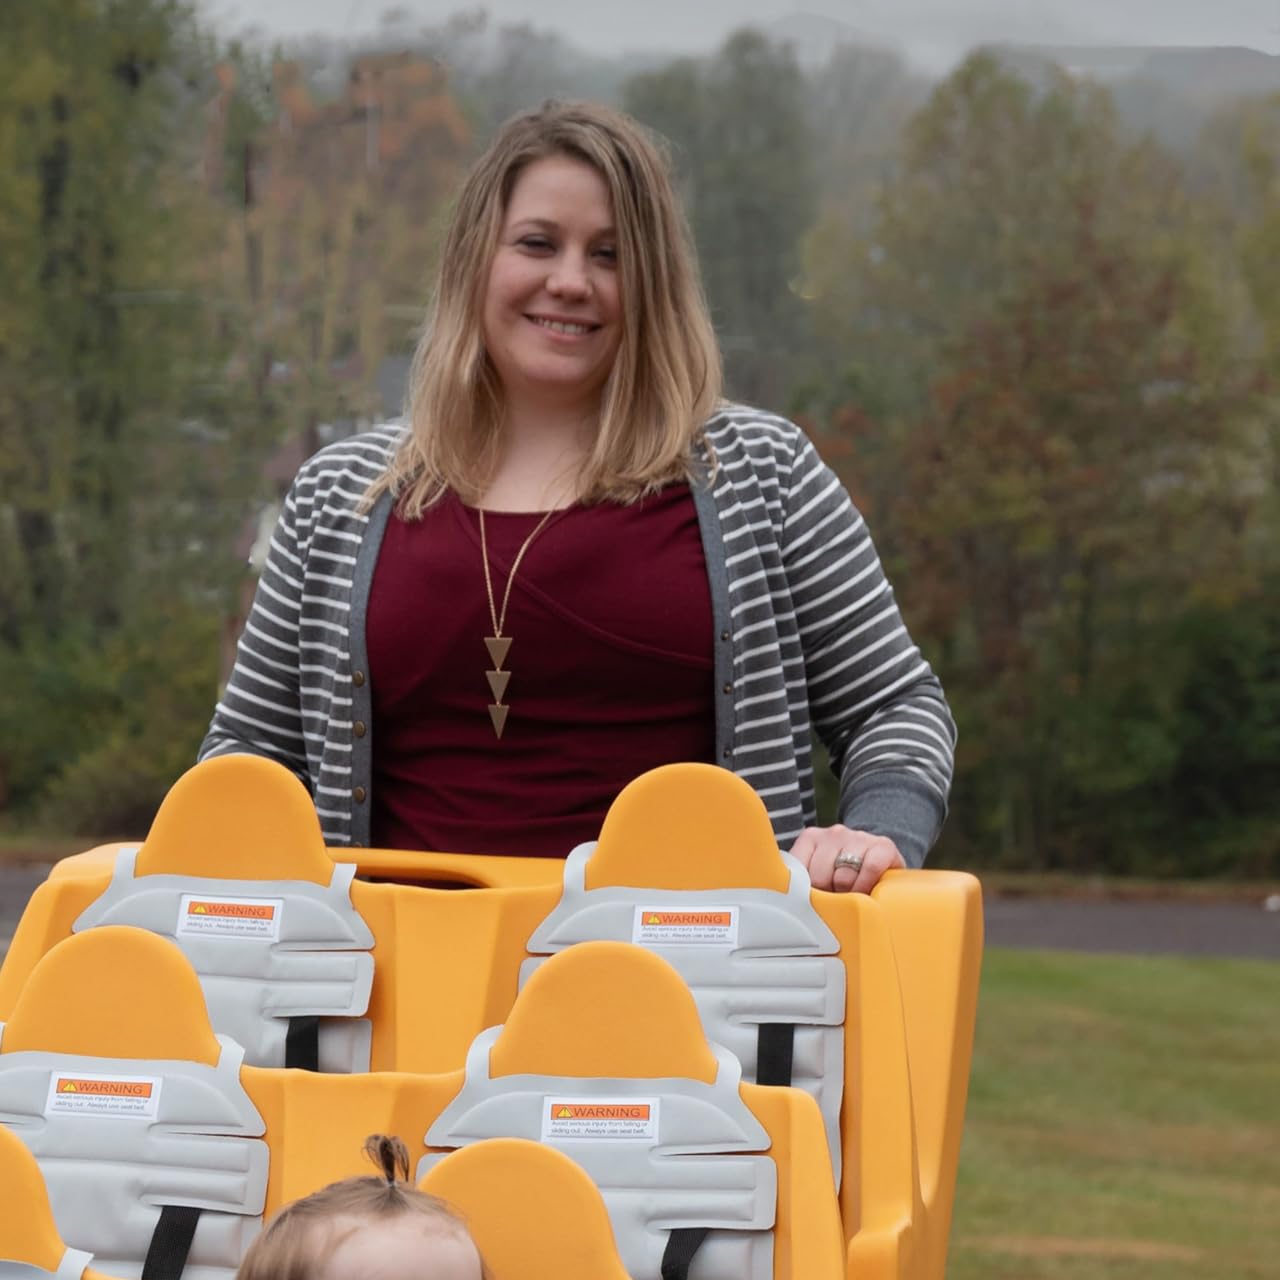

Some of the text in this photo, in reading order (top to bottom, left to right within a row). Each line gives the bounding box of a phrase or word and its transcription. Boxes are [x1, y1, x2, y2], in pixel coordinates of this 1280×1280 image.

[207, 905, 266, 916] WARNING
[662, 914, 722, 924] WARNING
[79, 1082, 143, 1094] WARNING
[574, 1107, 641, 1118] WARNING
